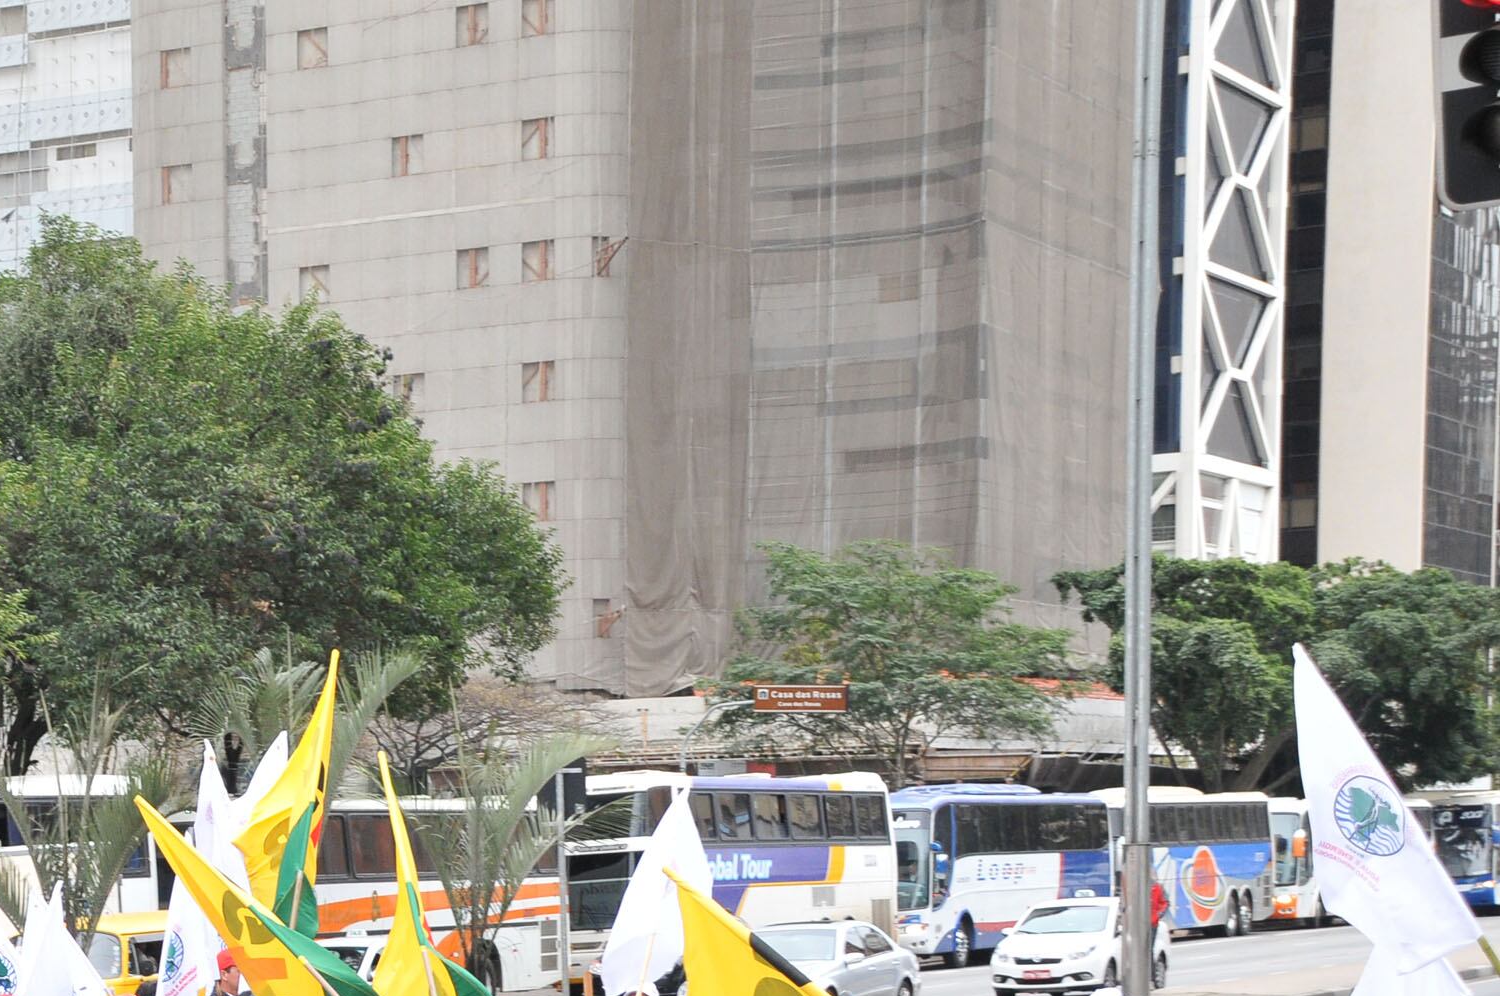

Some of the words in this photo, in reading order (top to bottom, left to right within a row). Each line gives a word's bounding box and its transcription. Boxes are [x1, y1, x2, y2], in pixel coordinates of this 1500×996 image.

[770, 690, 794, 699] Casa
[795, 690, 811, 699] das
[812, 690, 842, 699] Rosas
[740, 853, 773, 879] Tour
